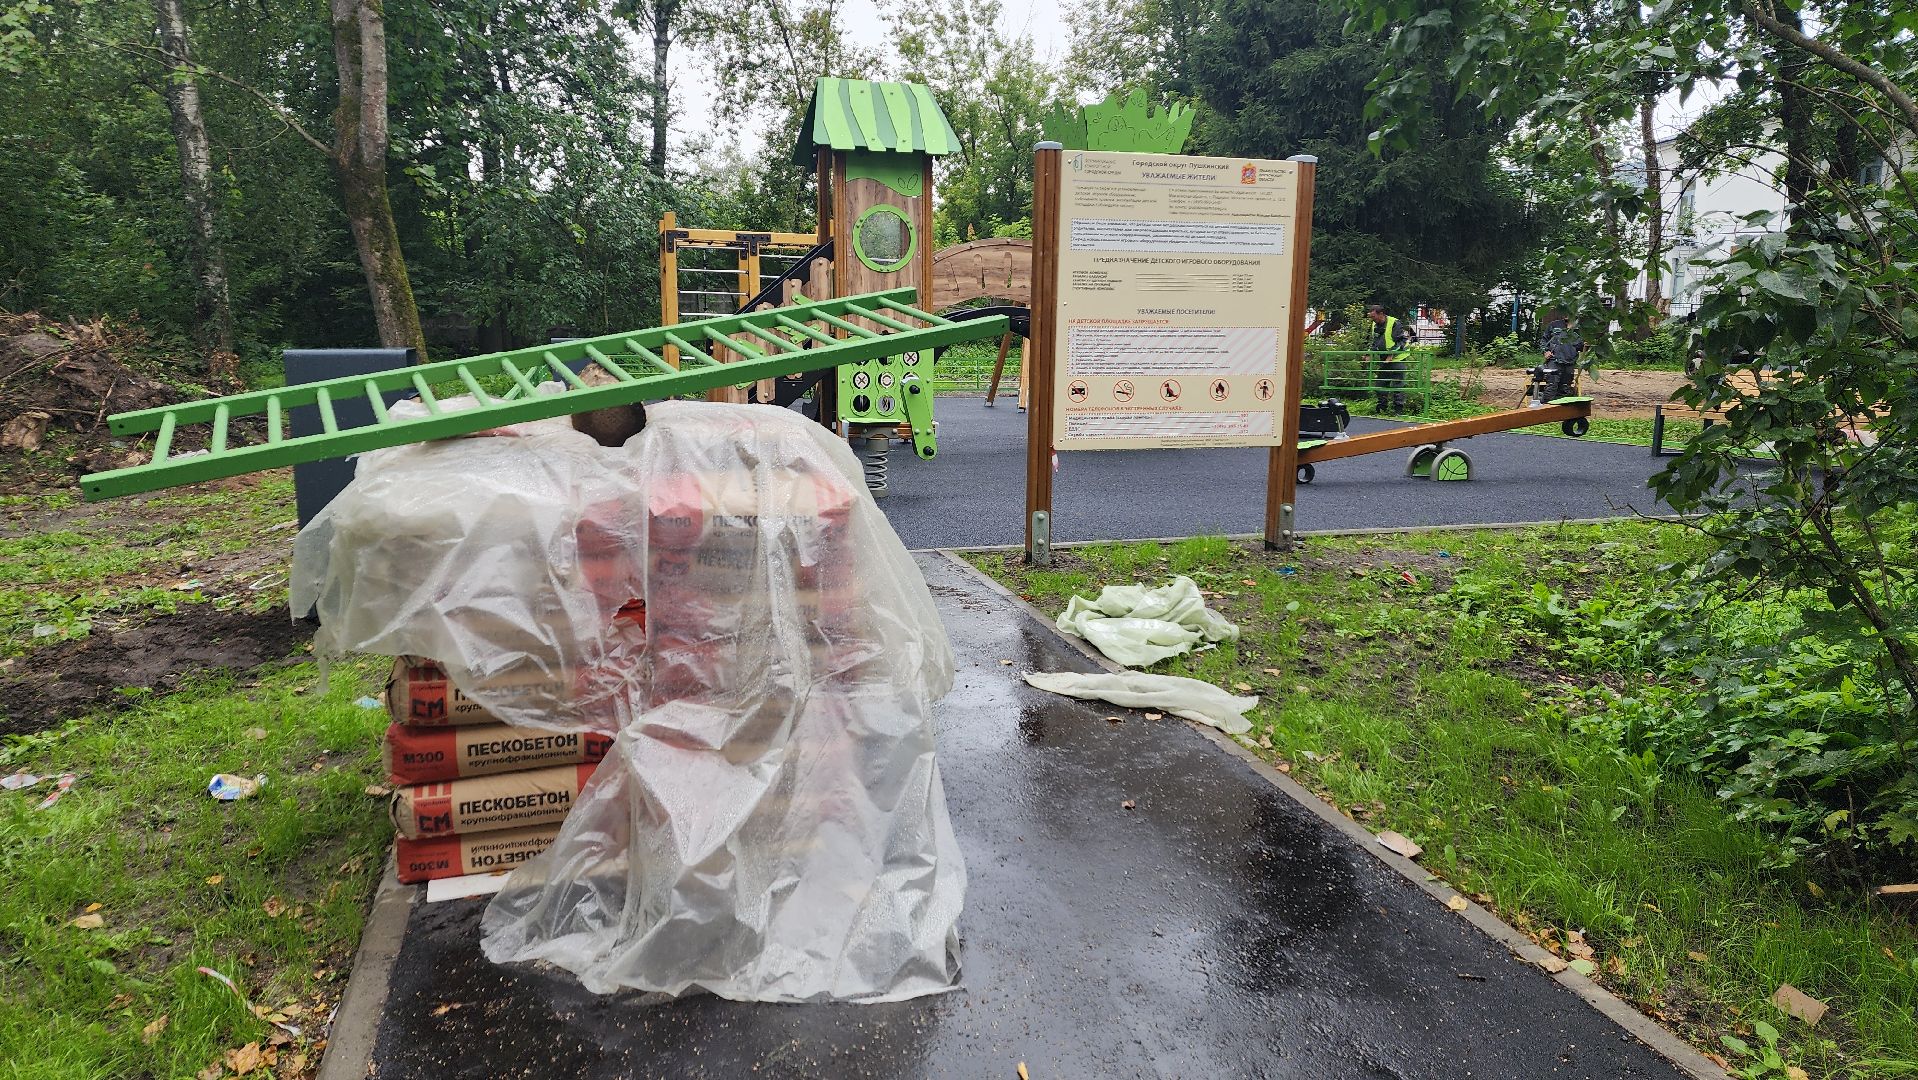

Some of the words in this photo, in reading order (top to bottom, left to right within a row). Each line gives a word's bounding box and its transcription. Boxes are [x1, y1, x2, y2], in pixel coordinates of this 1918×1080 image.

[1189, 162, 1230, 171] Пушкинский
[1142, 172, 1186, 181] УВАЖАЕМЫЕ
[1187, 173, 1216, 182] ЖИТЕЛИ
[1137, 308, 1175, 316] УВАЖАЕМЫЕ
[412, 697, 444, 718] СМ
[467, 733, 578, 757] ПЕСКОБЕТОН
[403, 750, 445, 764] М300
[468, 749, 578, 768] крупнофракционный
[459, 790, 570, 815] ПЕСКОБЕТОН
[418, 811, 450, 833] СМ
[460, 806, 570, 827] крупнофракционный
[409, 859, 449, 873] М300
